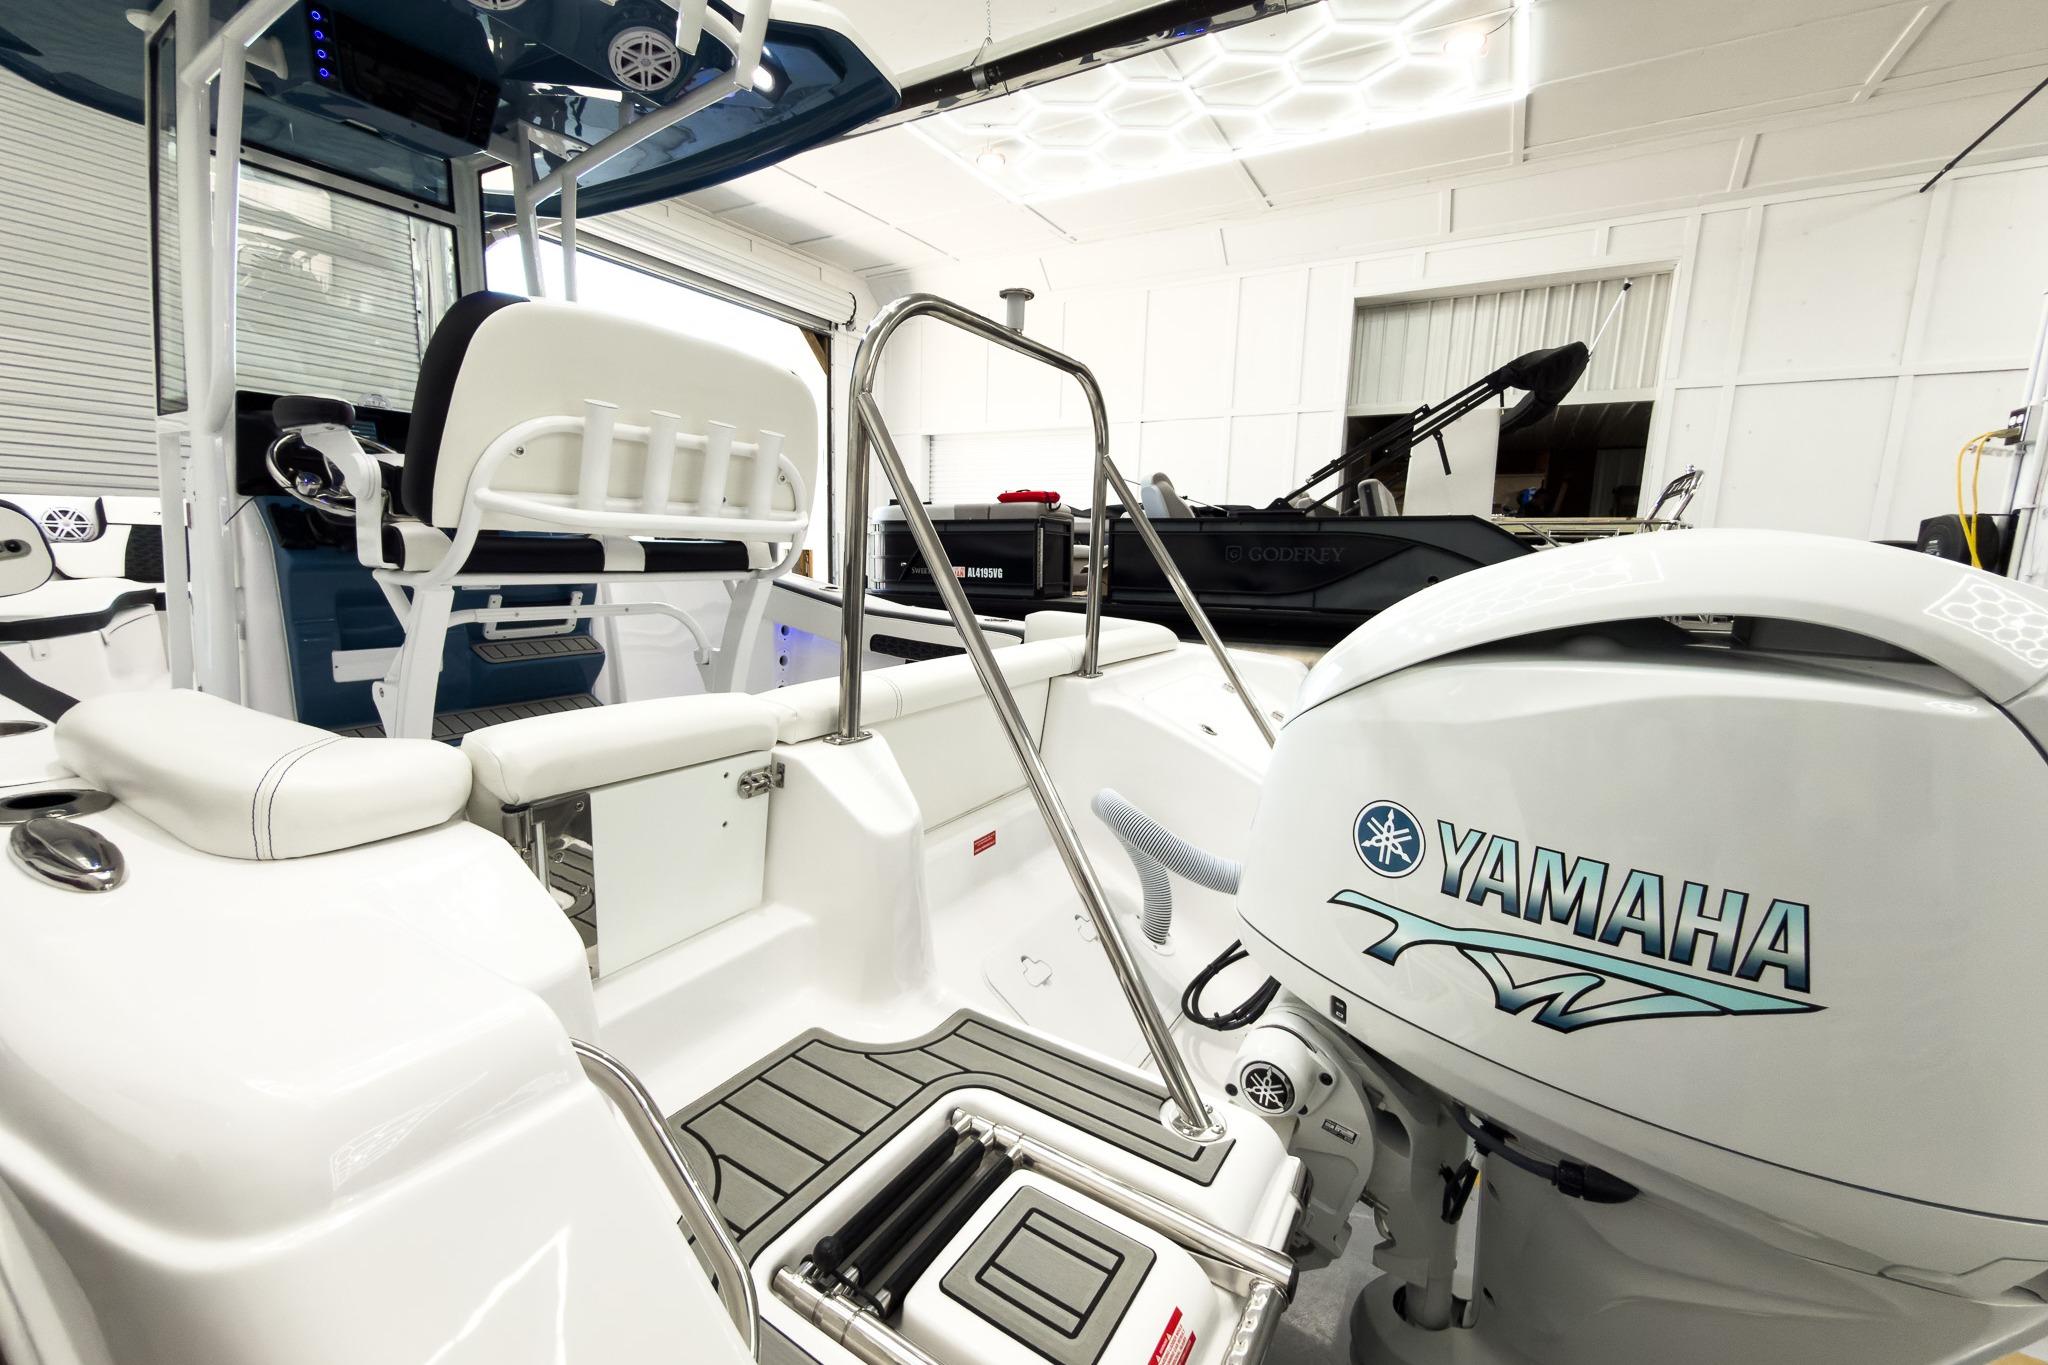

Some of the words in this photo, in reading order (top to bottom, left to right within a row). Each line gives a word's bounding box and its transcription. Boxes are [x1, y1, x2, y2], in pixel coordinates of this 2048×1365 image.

[1248, 546, 1345, 565] GODFREY
[967, 567, 1003, 578] AL4195VG
[1437, 819, 1811, 994] YAMAHA
